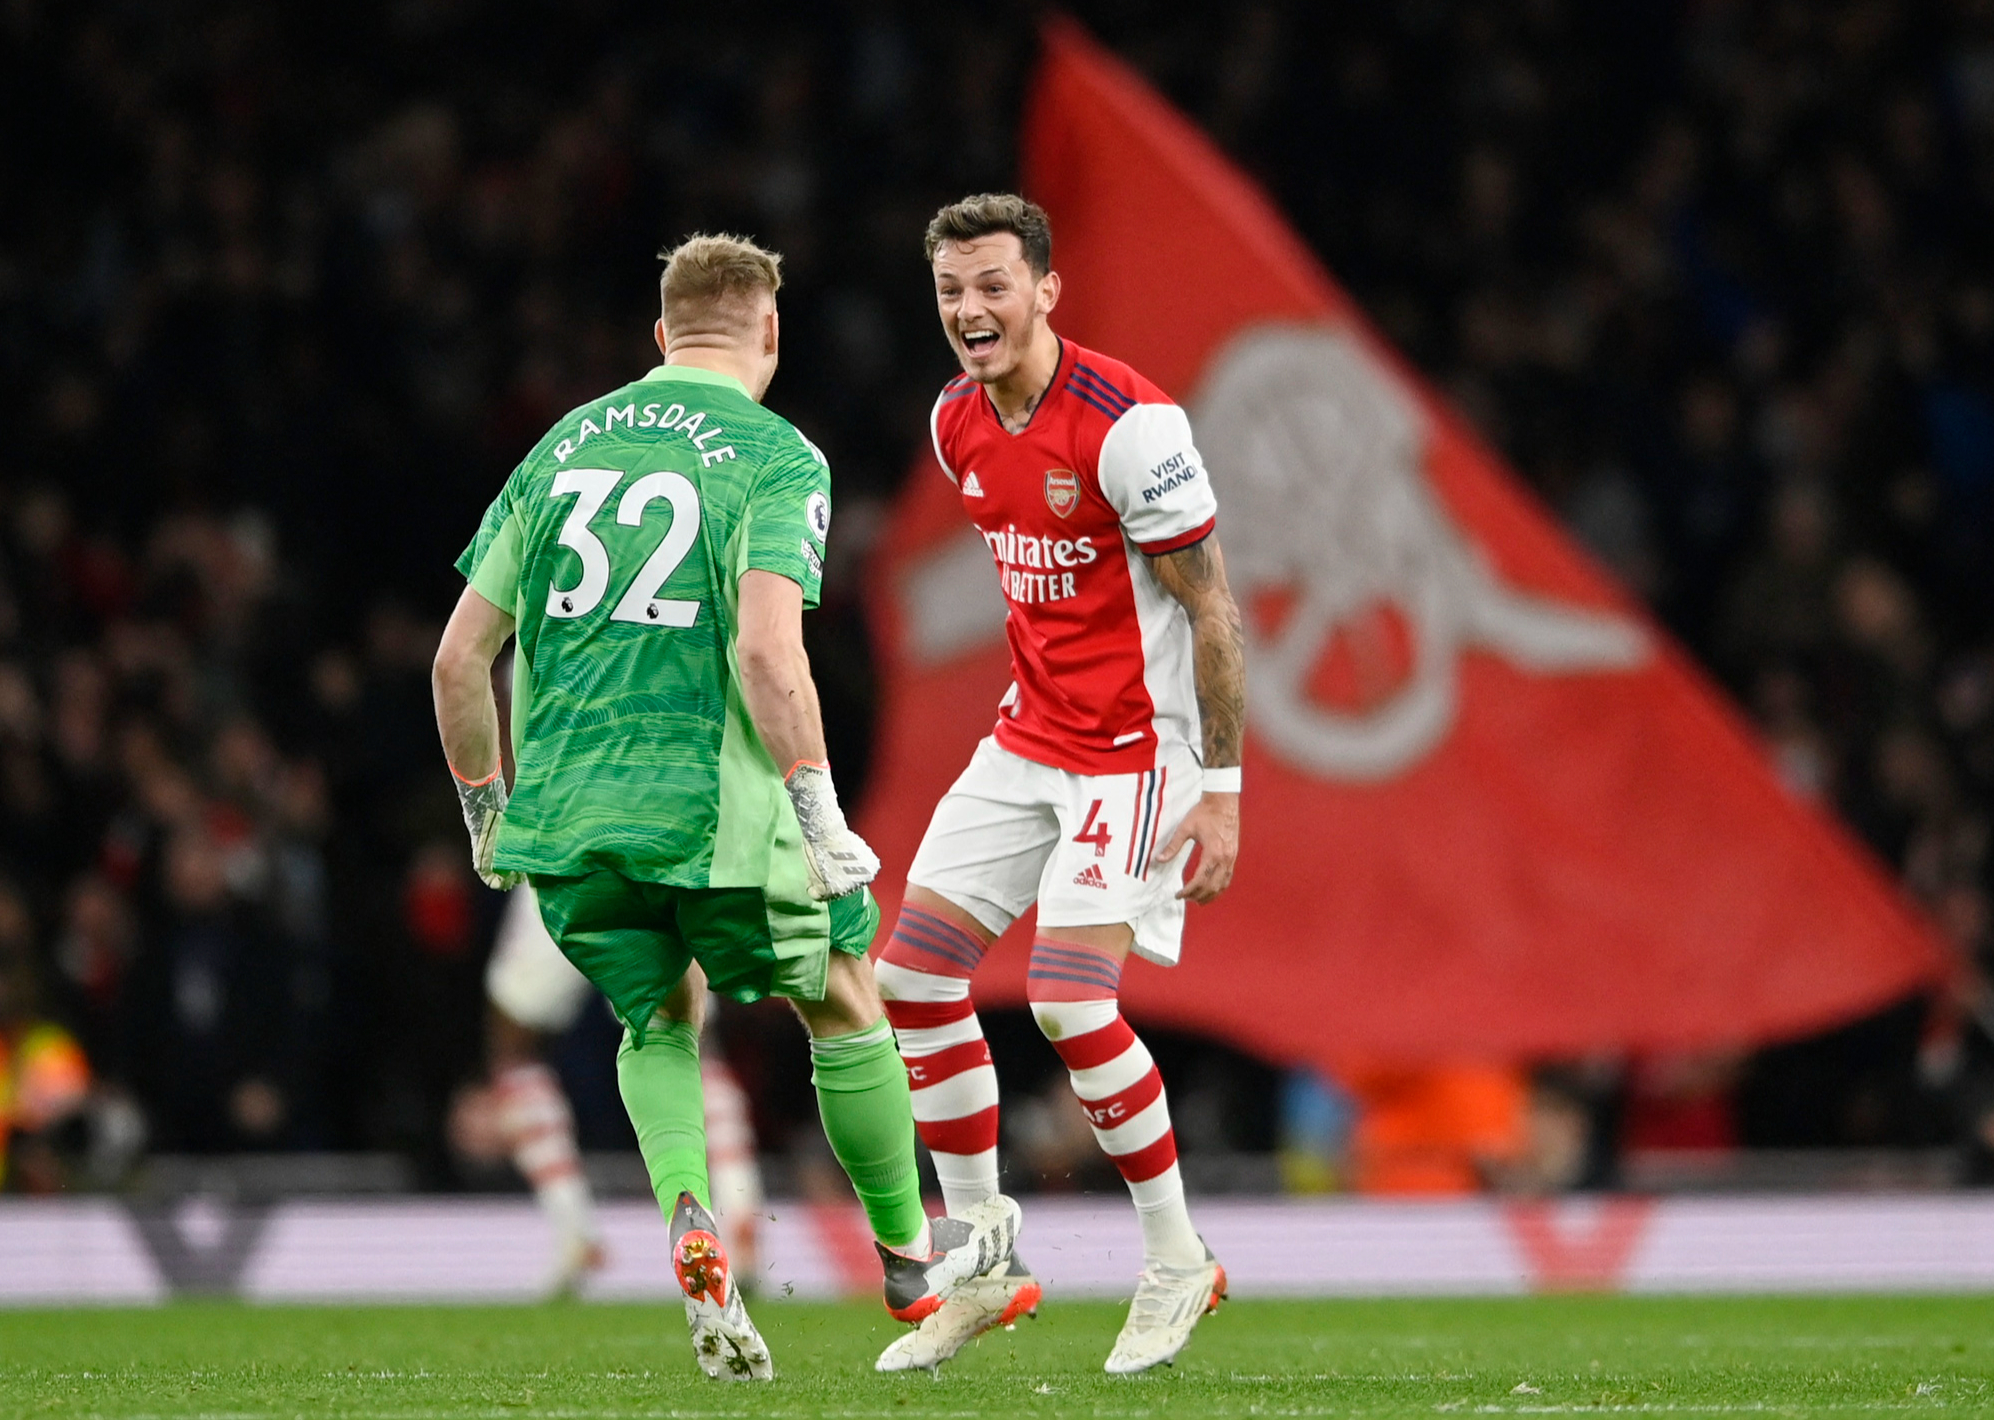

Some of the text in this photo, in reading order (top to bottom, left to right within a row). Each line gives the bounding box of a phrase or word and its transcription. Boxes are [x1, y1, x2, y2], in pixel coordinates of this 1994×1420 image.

[553, 403, 736, 468] RAMSDALE
[1142, 463, 1198, 503] RWAND
[1150, 451, 1185, 480] VISIT
[545, 468, 701, 628] 32
[974, 523, 1097, 568] mirates
[1010, 570, 1077, 604] BETTER
[1072, 799, 1112, 857] 4
[1073, 875, 1107, 890] adidas
